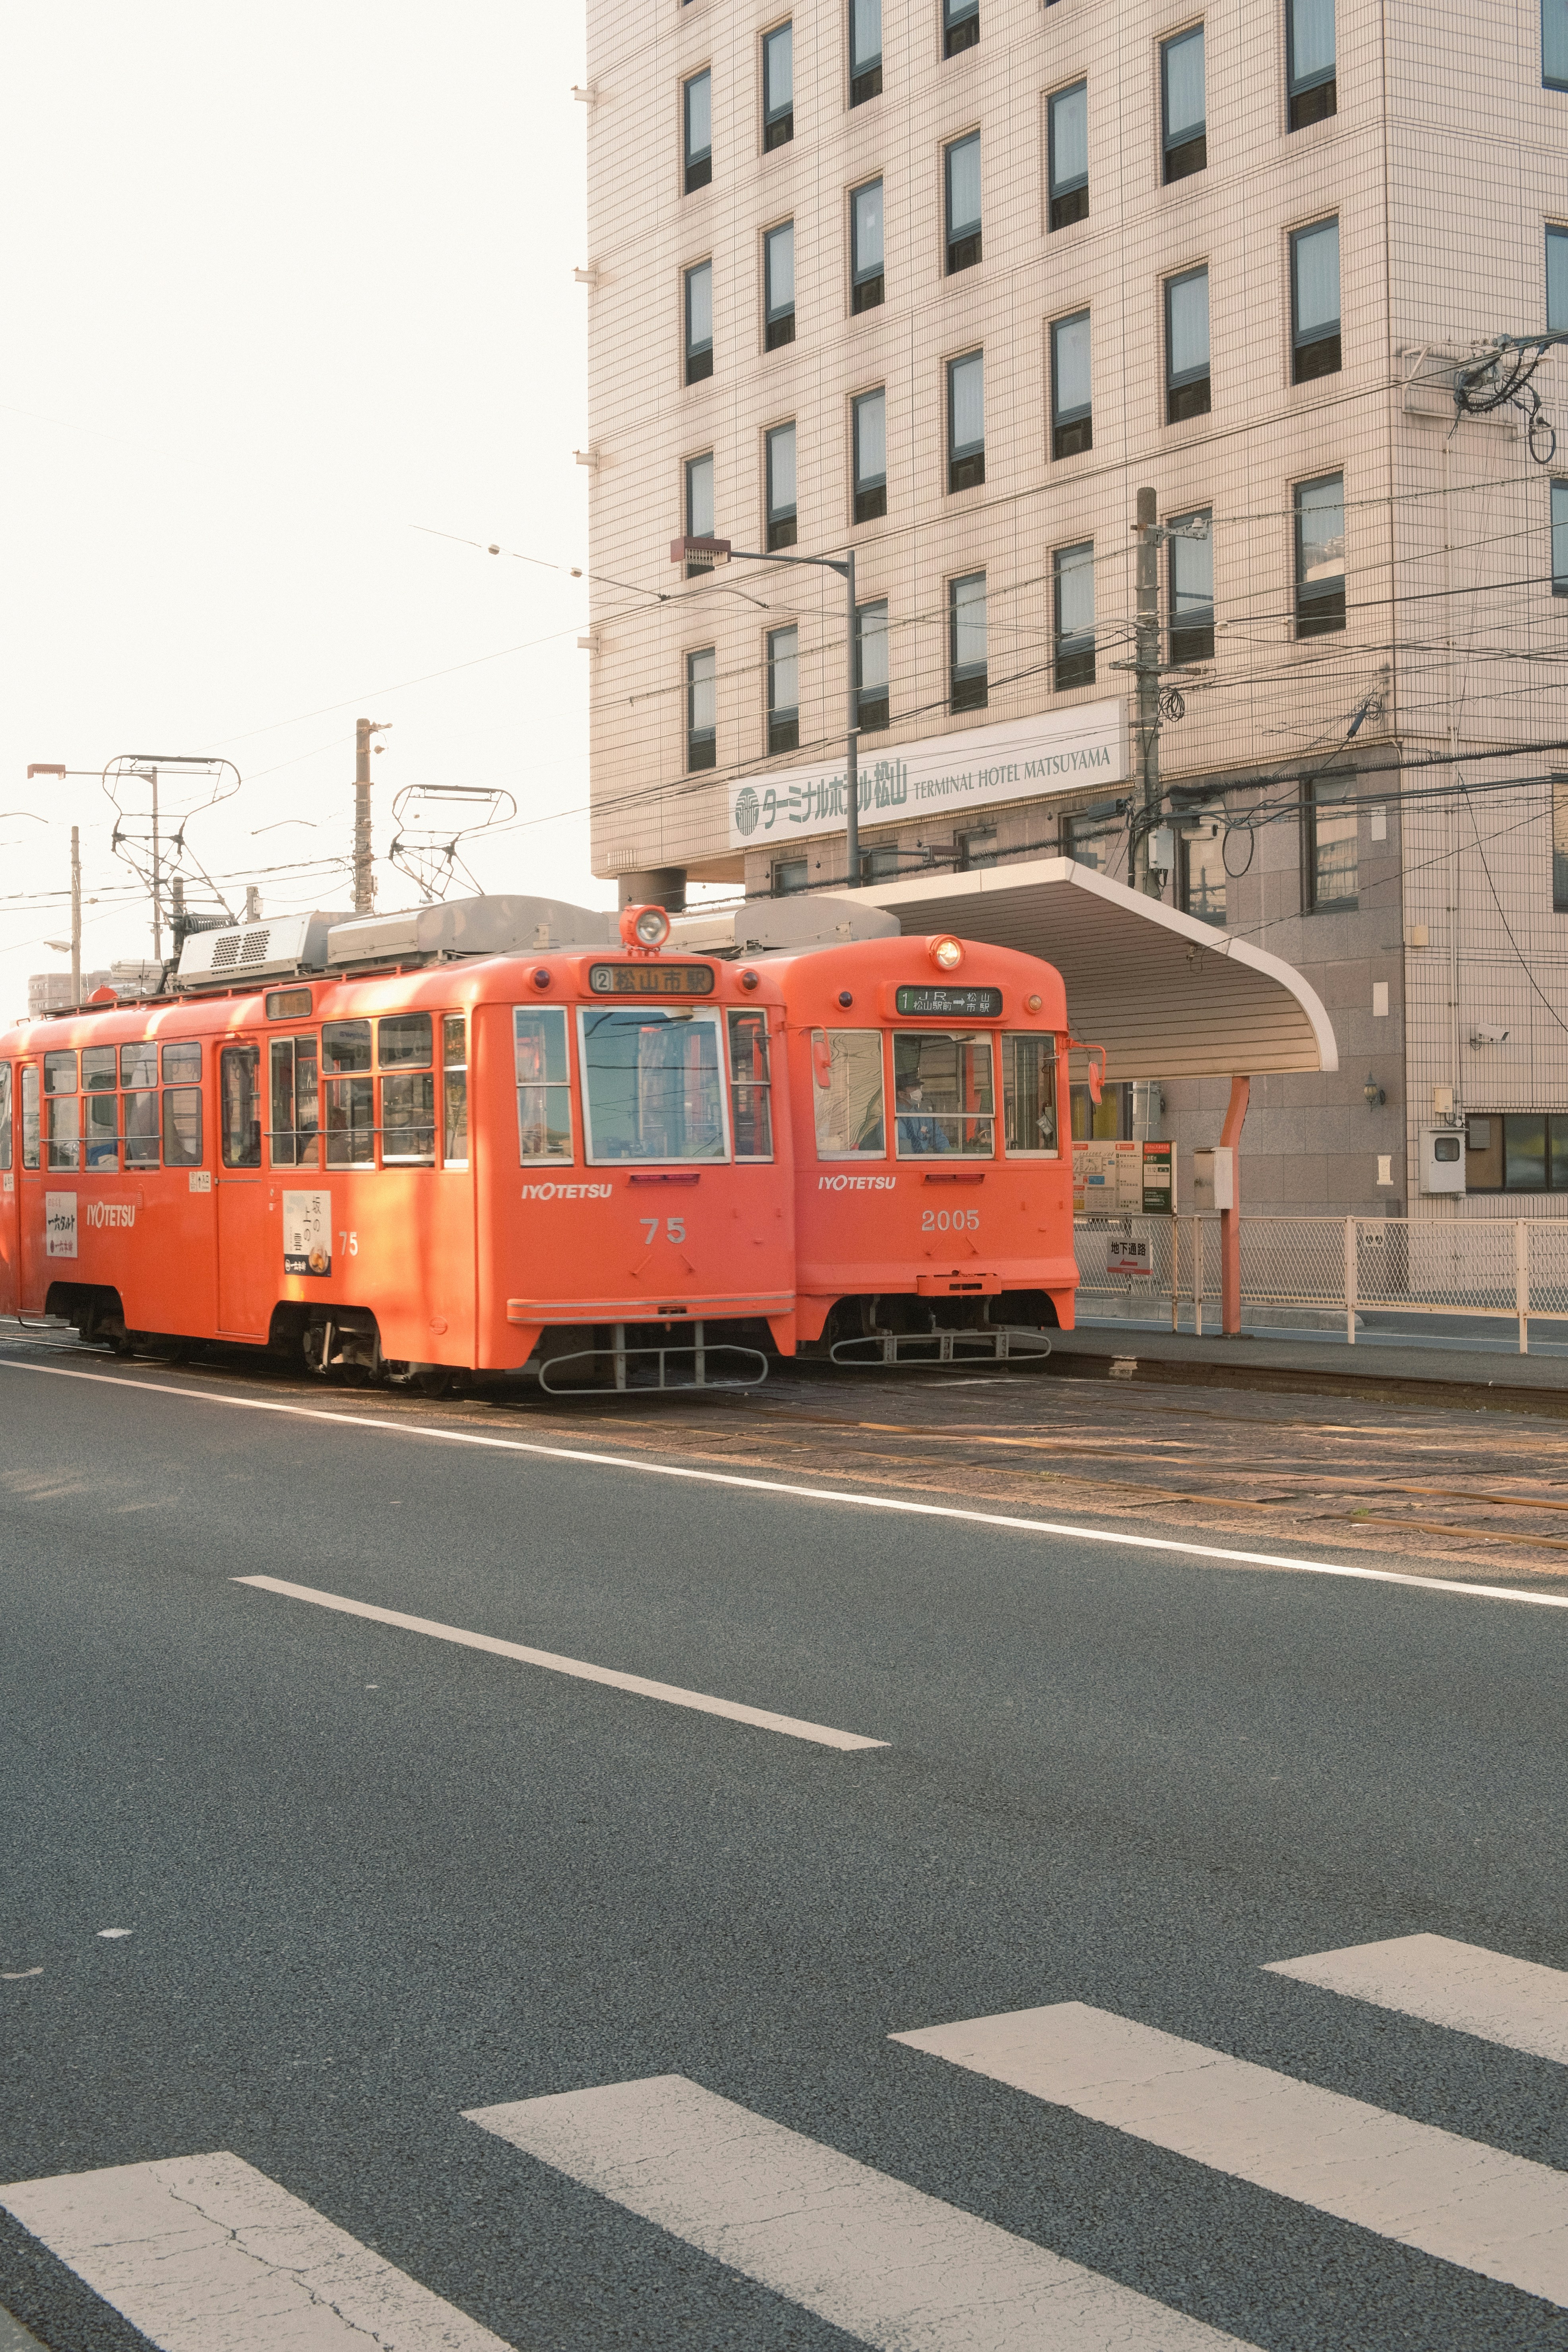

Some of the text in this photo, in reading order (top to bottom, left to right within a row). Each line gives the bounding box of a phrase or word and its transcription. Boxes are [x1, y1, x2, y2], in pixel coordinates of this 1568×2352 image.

[914, 747, 1110, 800] TERMINAL HOTEL MATSUYAMA
[599, 973, 607, 988] 2
[903, 993, 908, 1009] 1
[913, 1001, 952, 1010] 松山駅前
[521, 1182, 612, 1200] IYOTETSU
[818, 1174, 896, 1191] IYOTETSU
[87, 1201, 136, 1228] IYOTETSU
[922, 1210, 979, 1231] 2005
[640, 1217, 686, 1245] 75
[339, 1231, 358, 1256] 75
[1111, 1241, 1146, 1256] 地下通路
